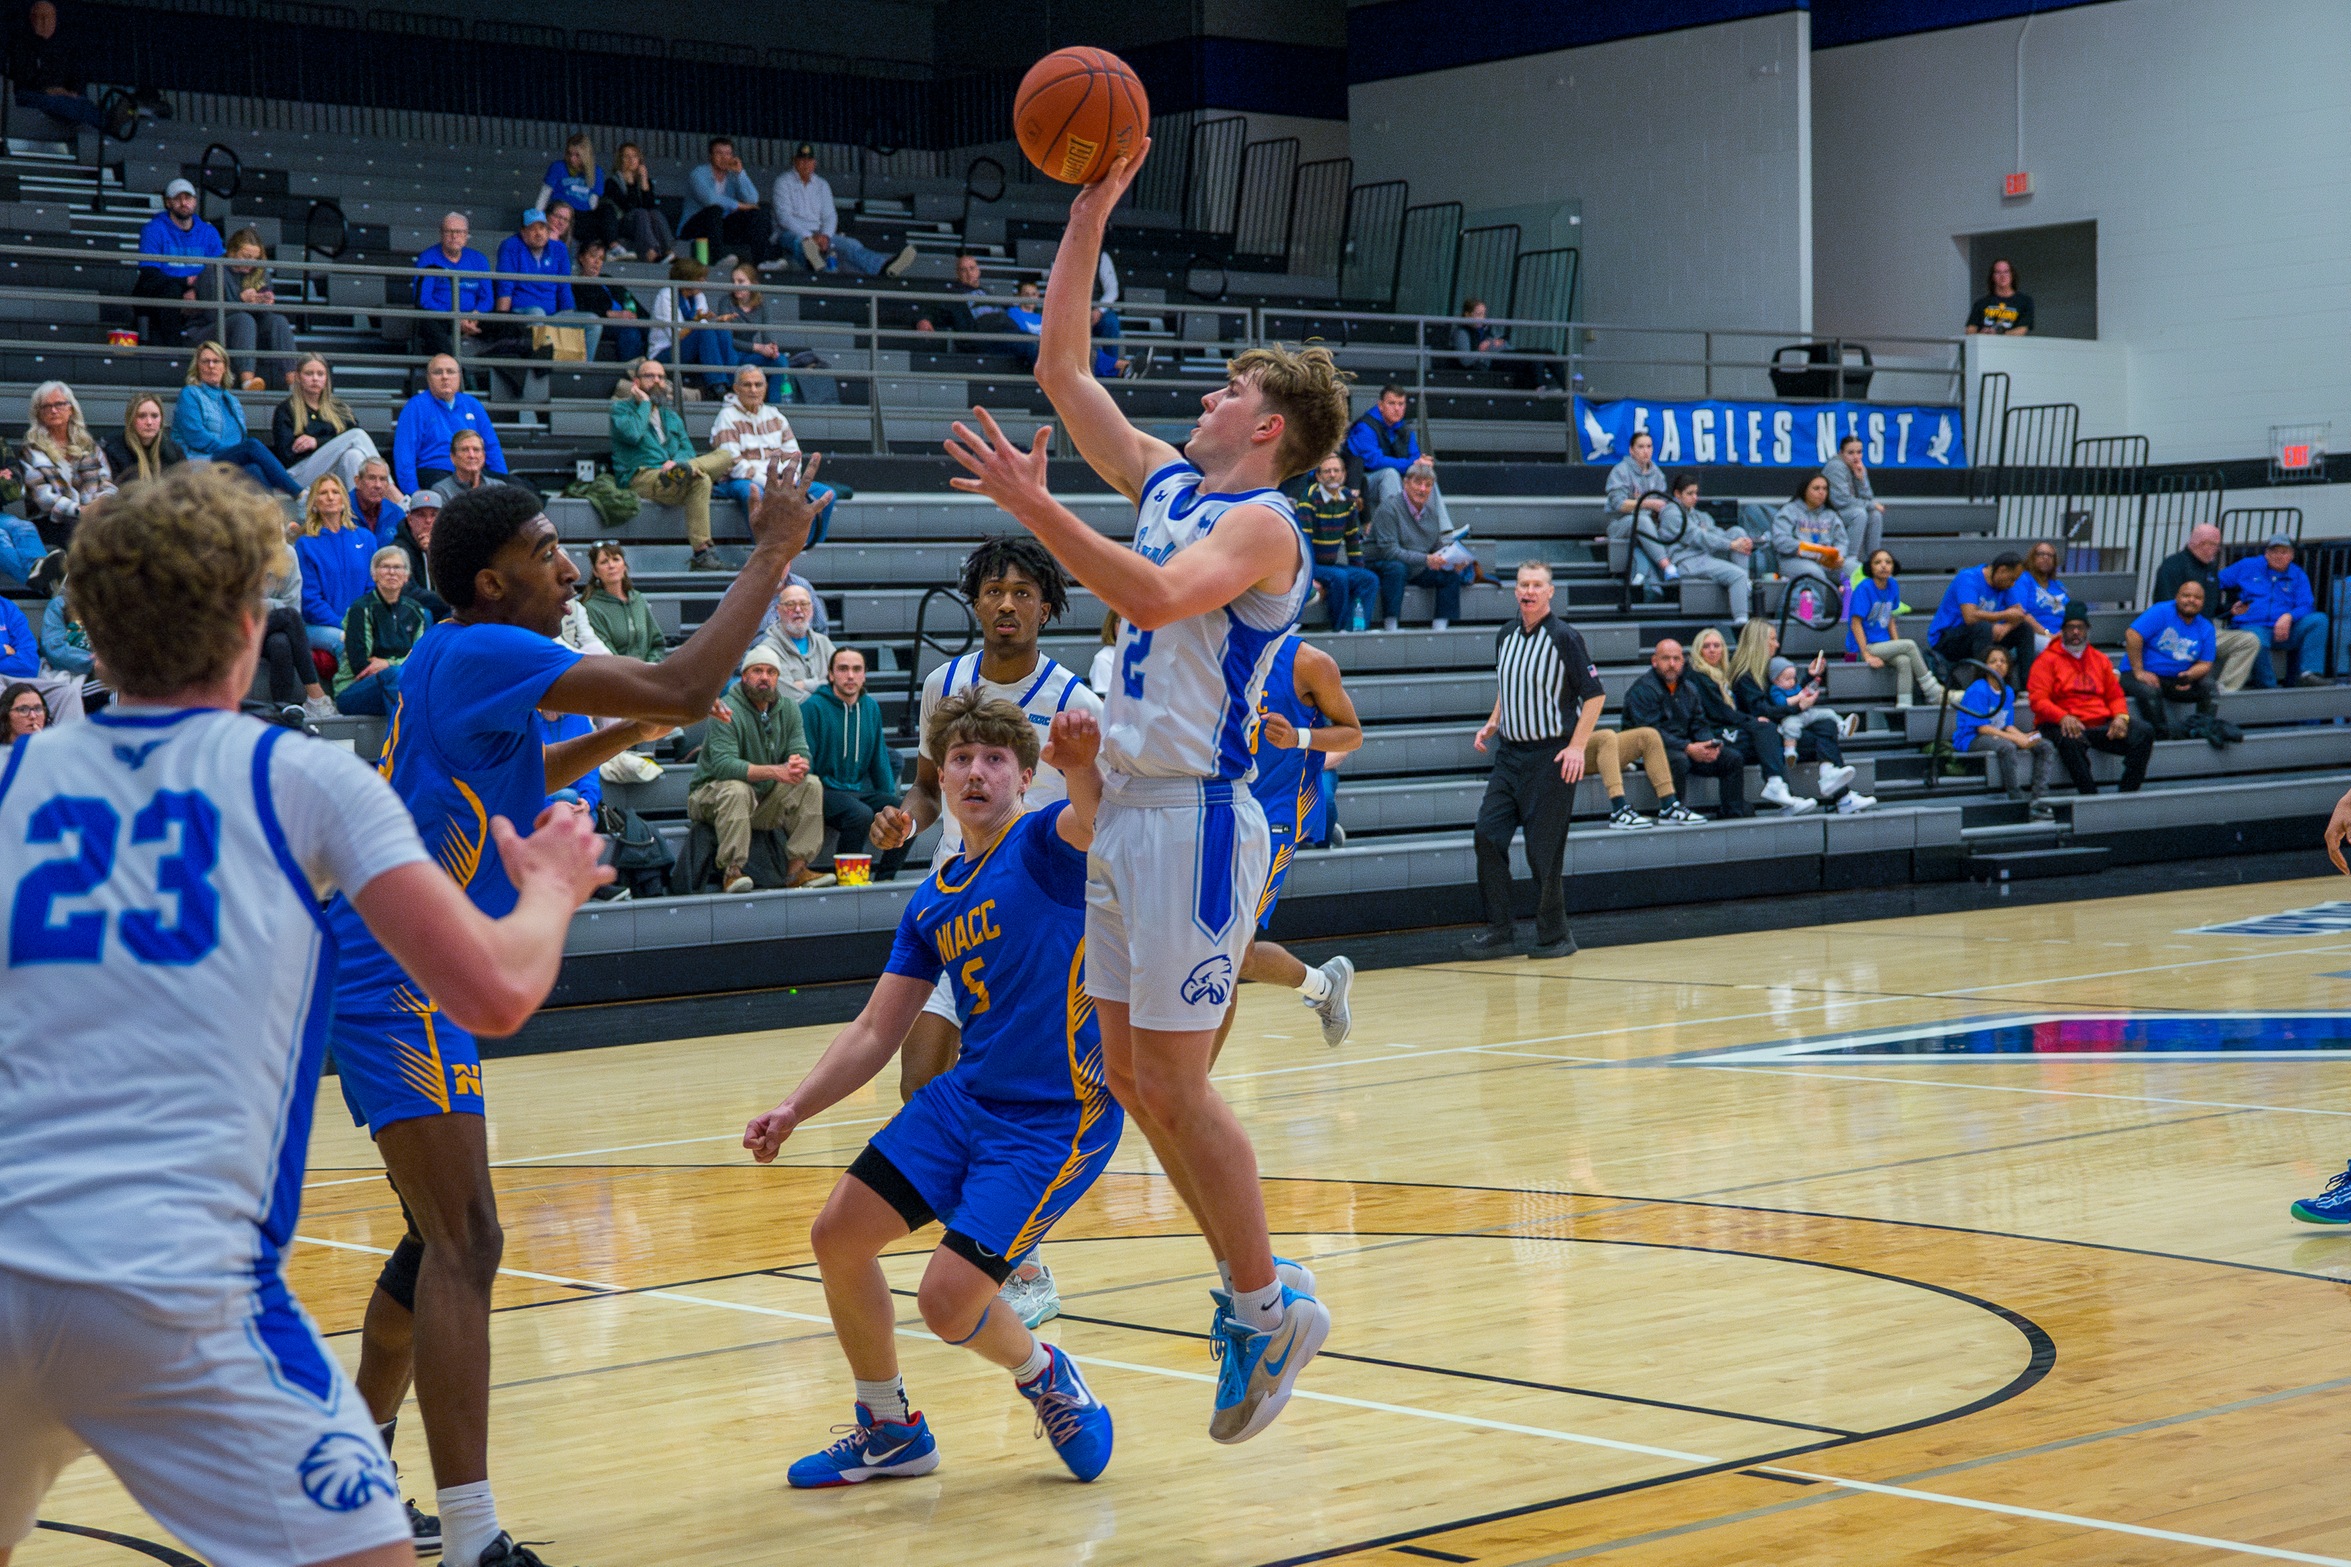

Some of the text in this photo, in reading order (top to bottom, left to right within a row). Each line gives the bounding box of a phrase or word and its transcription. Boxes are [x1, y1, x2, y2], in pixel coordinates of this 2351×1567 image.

[2006, 172, 2028, 195] EXIT
[2284, 445, 2309, 468] EXIT
[8, 787, 221, 968] 23
[935, 898, 1001, 966] NIACC
[961, 956, 991, 1015] 5
